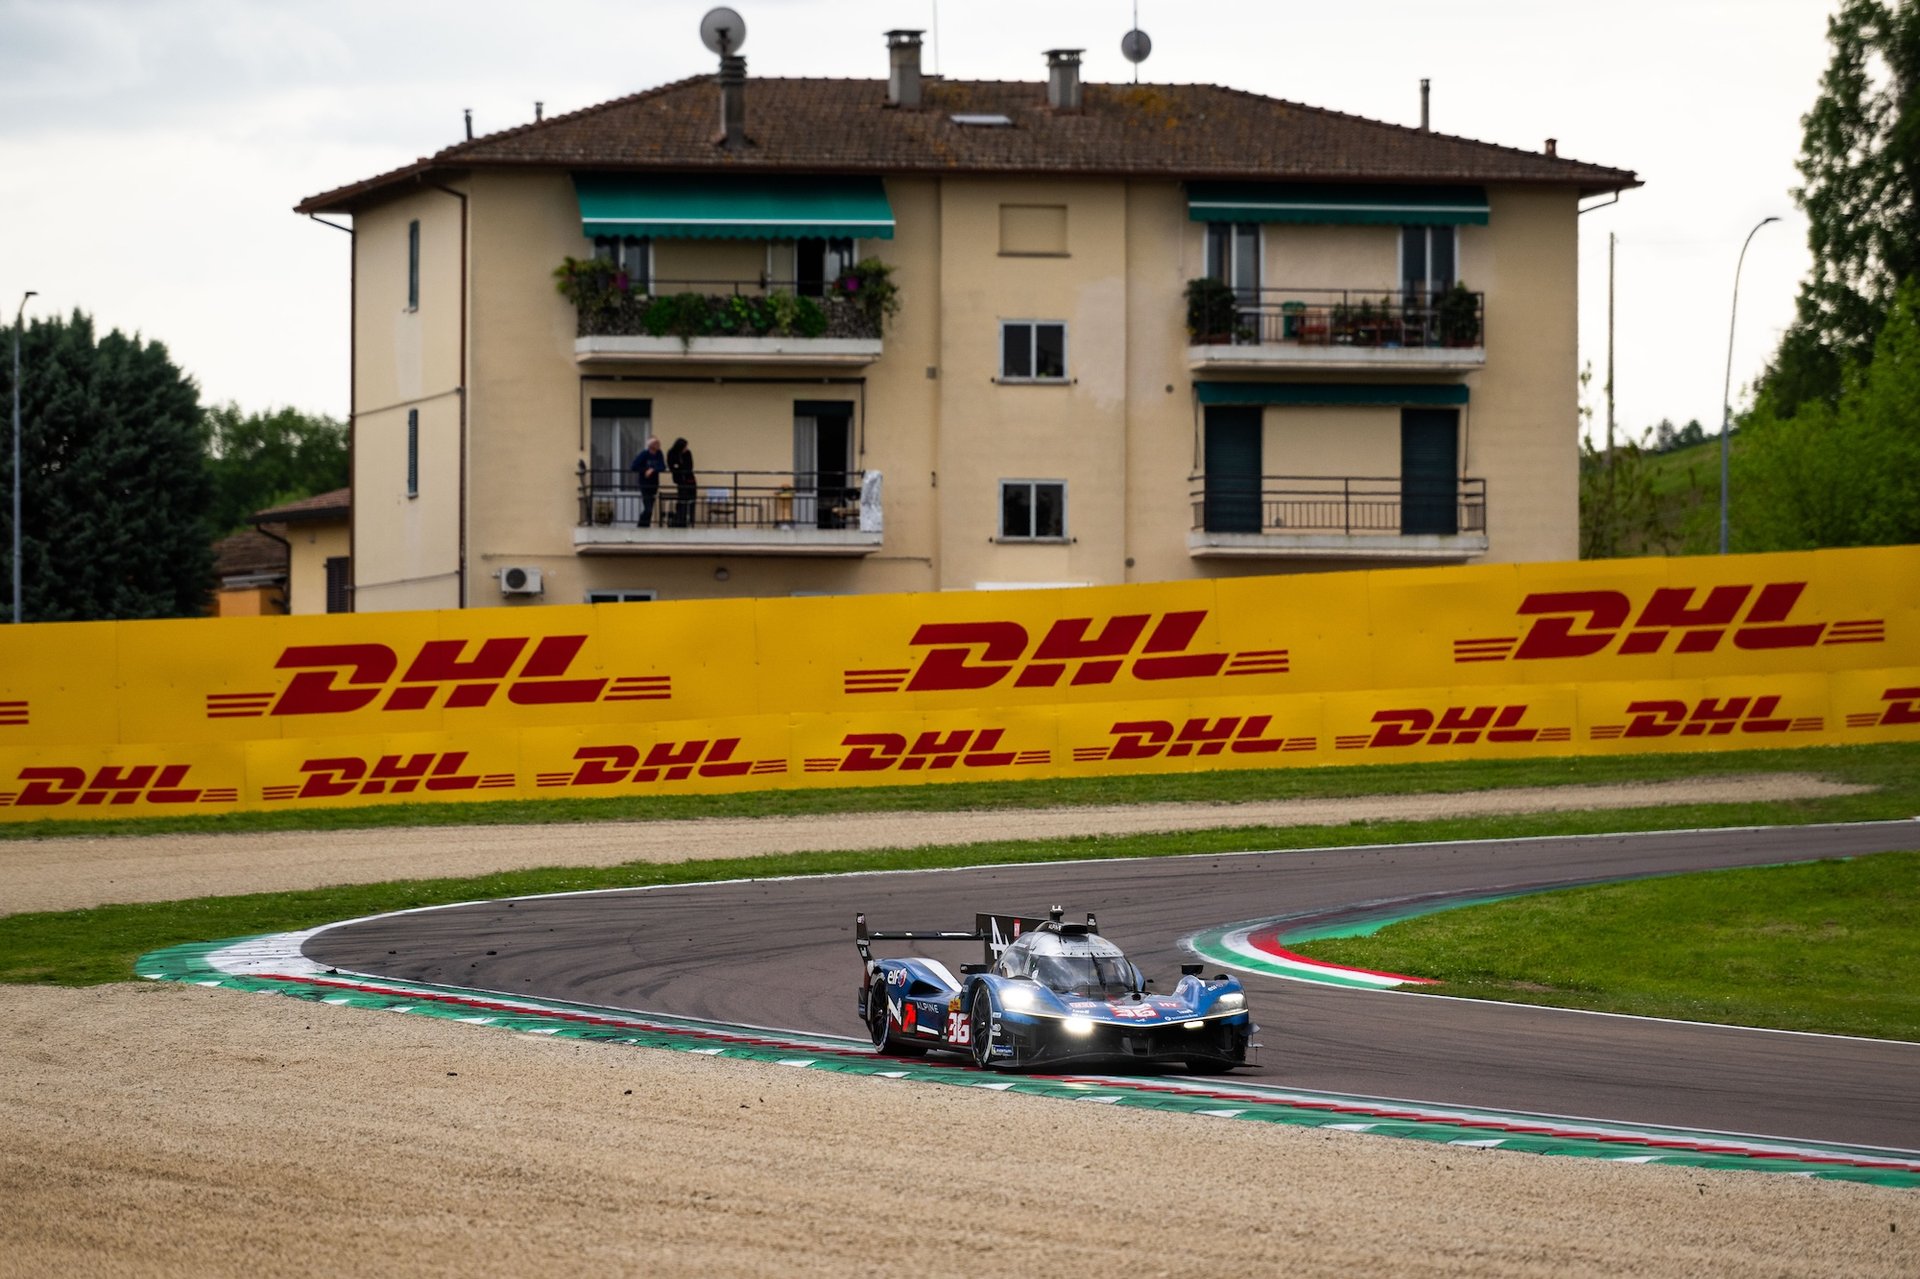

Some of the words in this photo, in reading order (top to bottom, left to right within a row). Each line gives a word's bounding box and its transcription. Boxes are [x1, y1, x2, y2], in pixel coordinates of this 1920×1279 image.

[1514, 582, 1827, 660] DHL
[906, 611, 1230, 691] DHL
[270, 635, 610, 716] DHL
[1108, 716, 1283, 760] DHL
[1369, 705, 1539, 747] DHL
[1625, 696, 1791, 738] DHL
[572, 738, 754, 785] DHL
[839, 729, 1017, 772] DHL
[16, 764, 204, 806] DHL
[299, 751, 481, 798] DHL
[887, 969, 900, 985] elf
[916, 1001, 940, 1014] ALPINE
[948, 1012, 970, 1043] 36
[1112, 1006, 1158, 1018] 36
